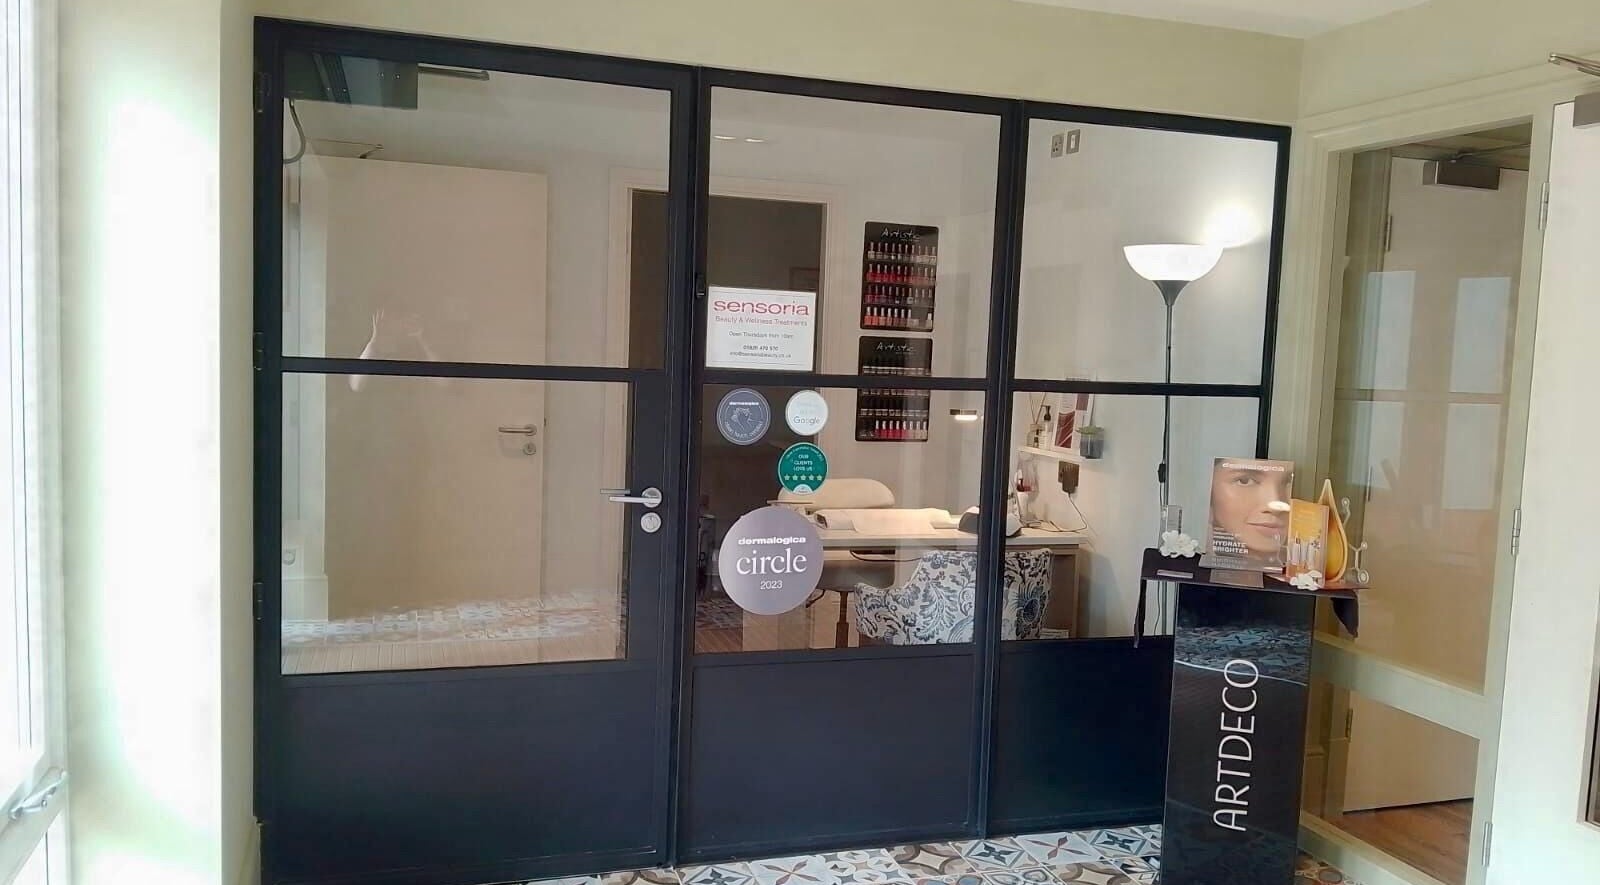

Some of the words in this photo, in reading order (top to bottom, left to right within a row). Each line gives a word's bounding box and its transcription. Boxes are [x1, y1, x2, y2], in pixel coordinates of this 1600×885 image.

[713, 300, 809, 316] sensoria
[715, 316, 737, 324] Beauty
[745, 317, 773, 325] Wellness
[793, 415, 821, 427] Google
[1222, 462, 1285, 472] dermalogica
[738, 536, 806, 545] dermalogica
[1213, 540, 1247, 548] HYDRATE
[1213, 546, 1249, 554] BRIGHTER
[736, 547, 807, 575] circle
[760, 580, 783, 590] 2023
[1213, 659, 1259, 832] ARTDECO
